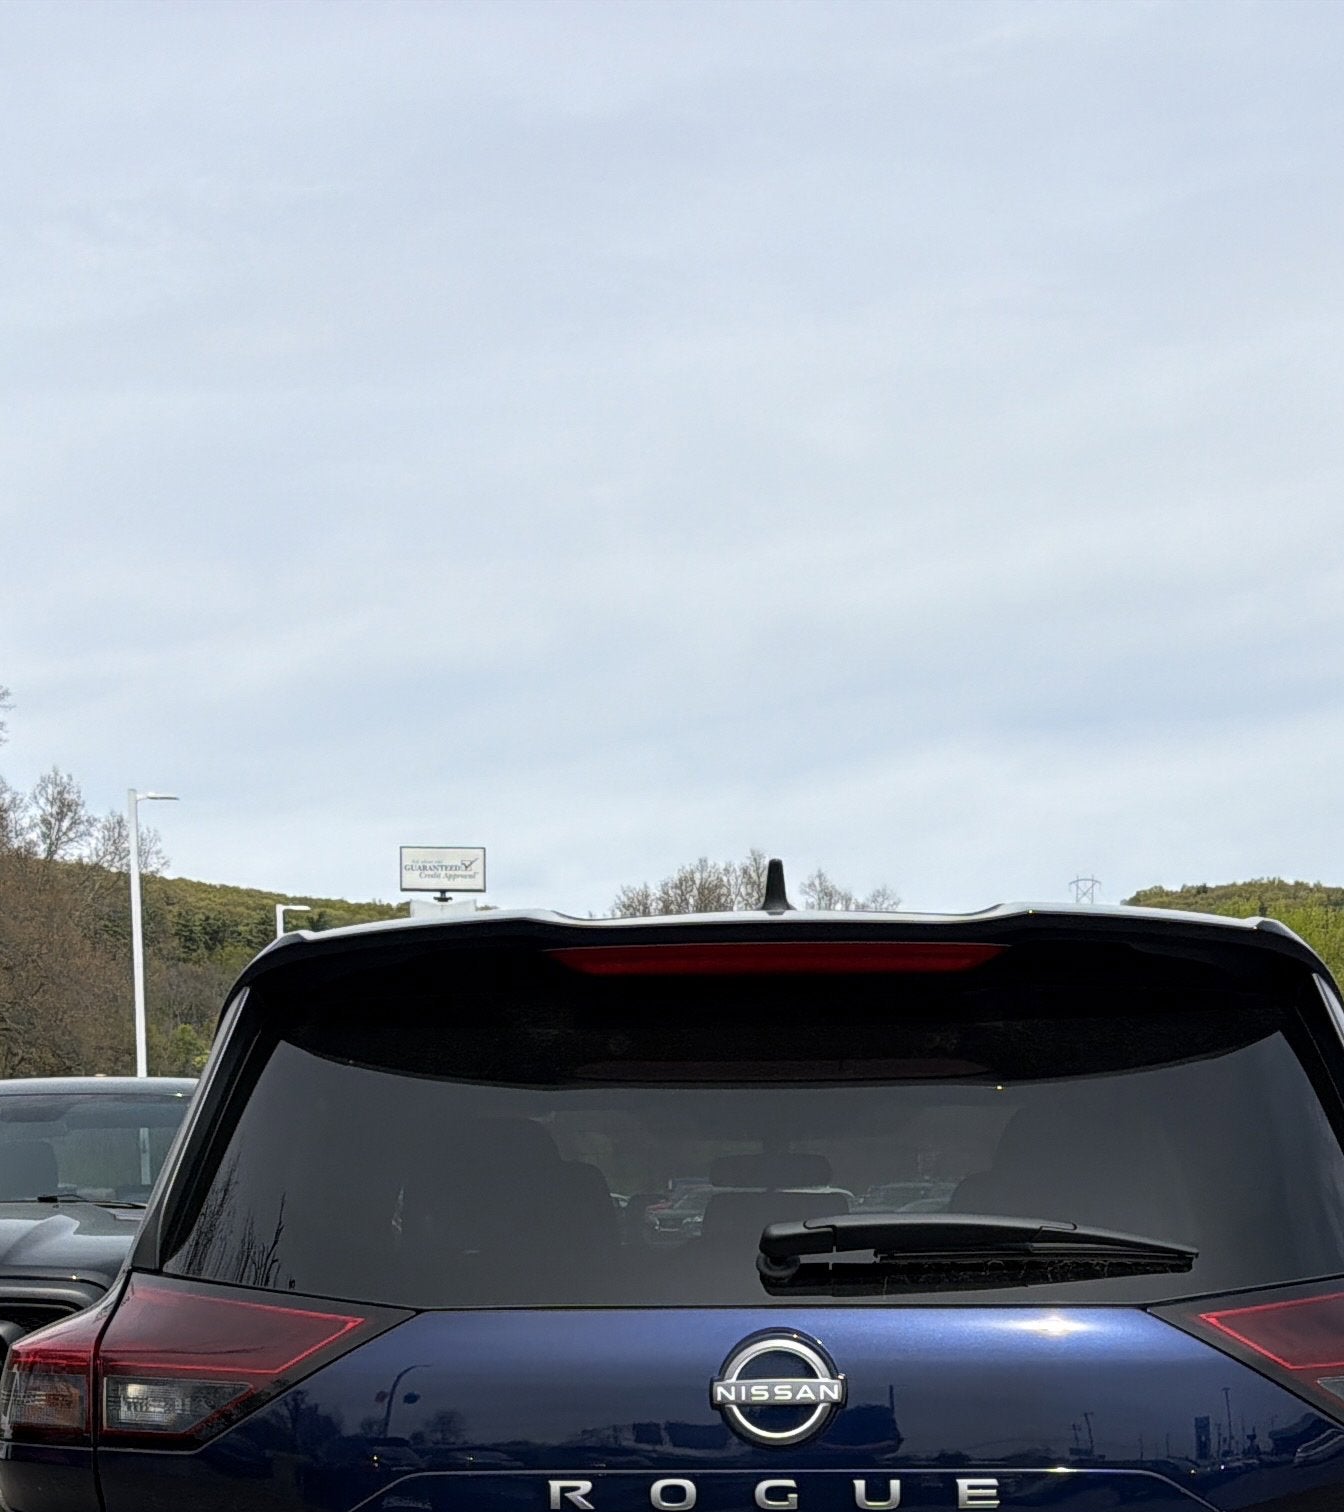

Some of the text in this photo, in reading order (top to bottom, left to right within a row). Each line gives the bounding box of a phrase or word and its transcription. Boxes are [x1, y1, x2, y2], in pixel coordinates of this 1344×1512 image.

[404, 864, 461, 872] GUARANTEED
[716, 1384, 839, 1401] NISSAN
[548, 1478, 1000, 1511] ROGUE
